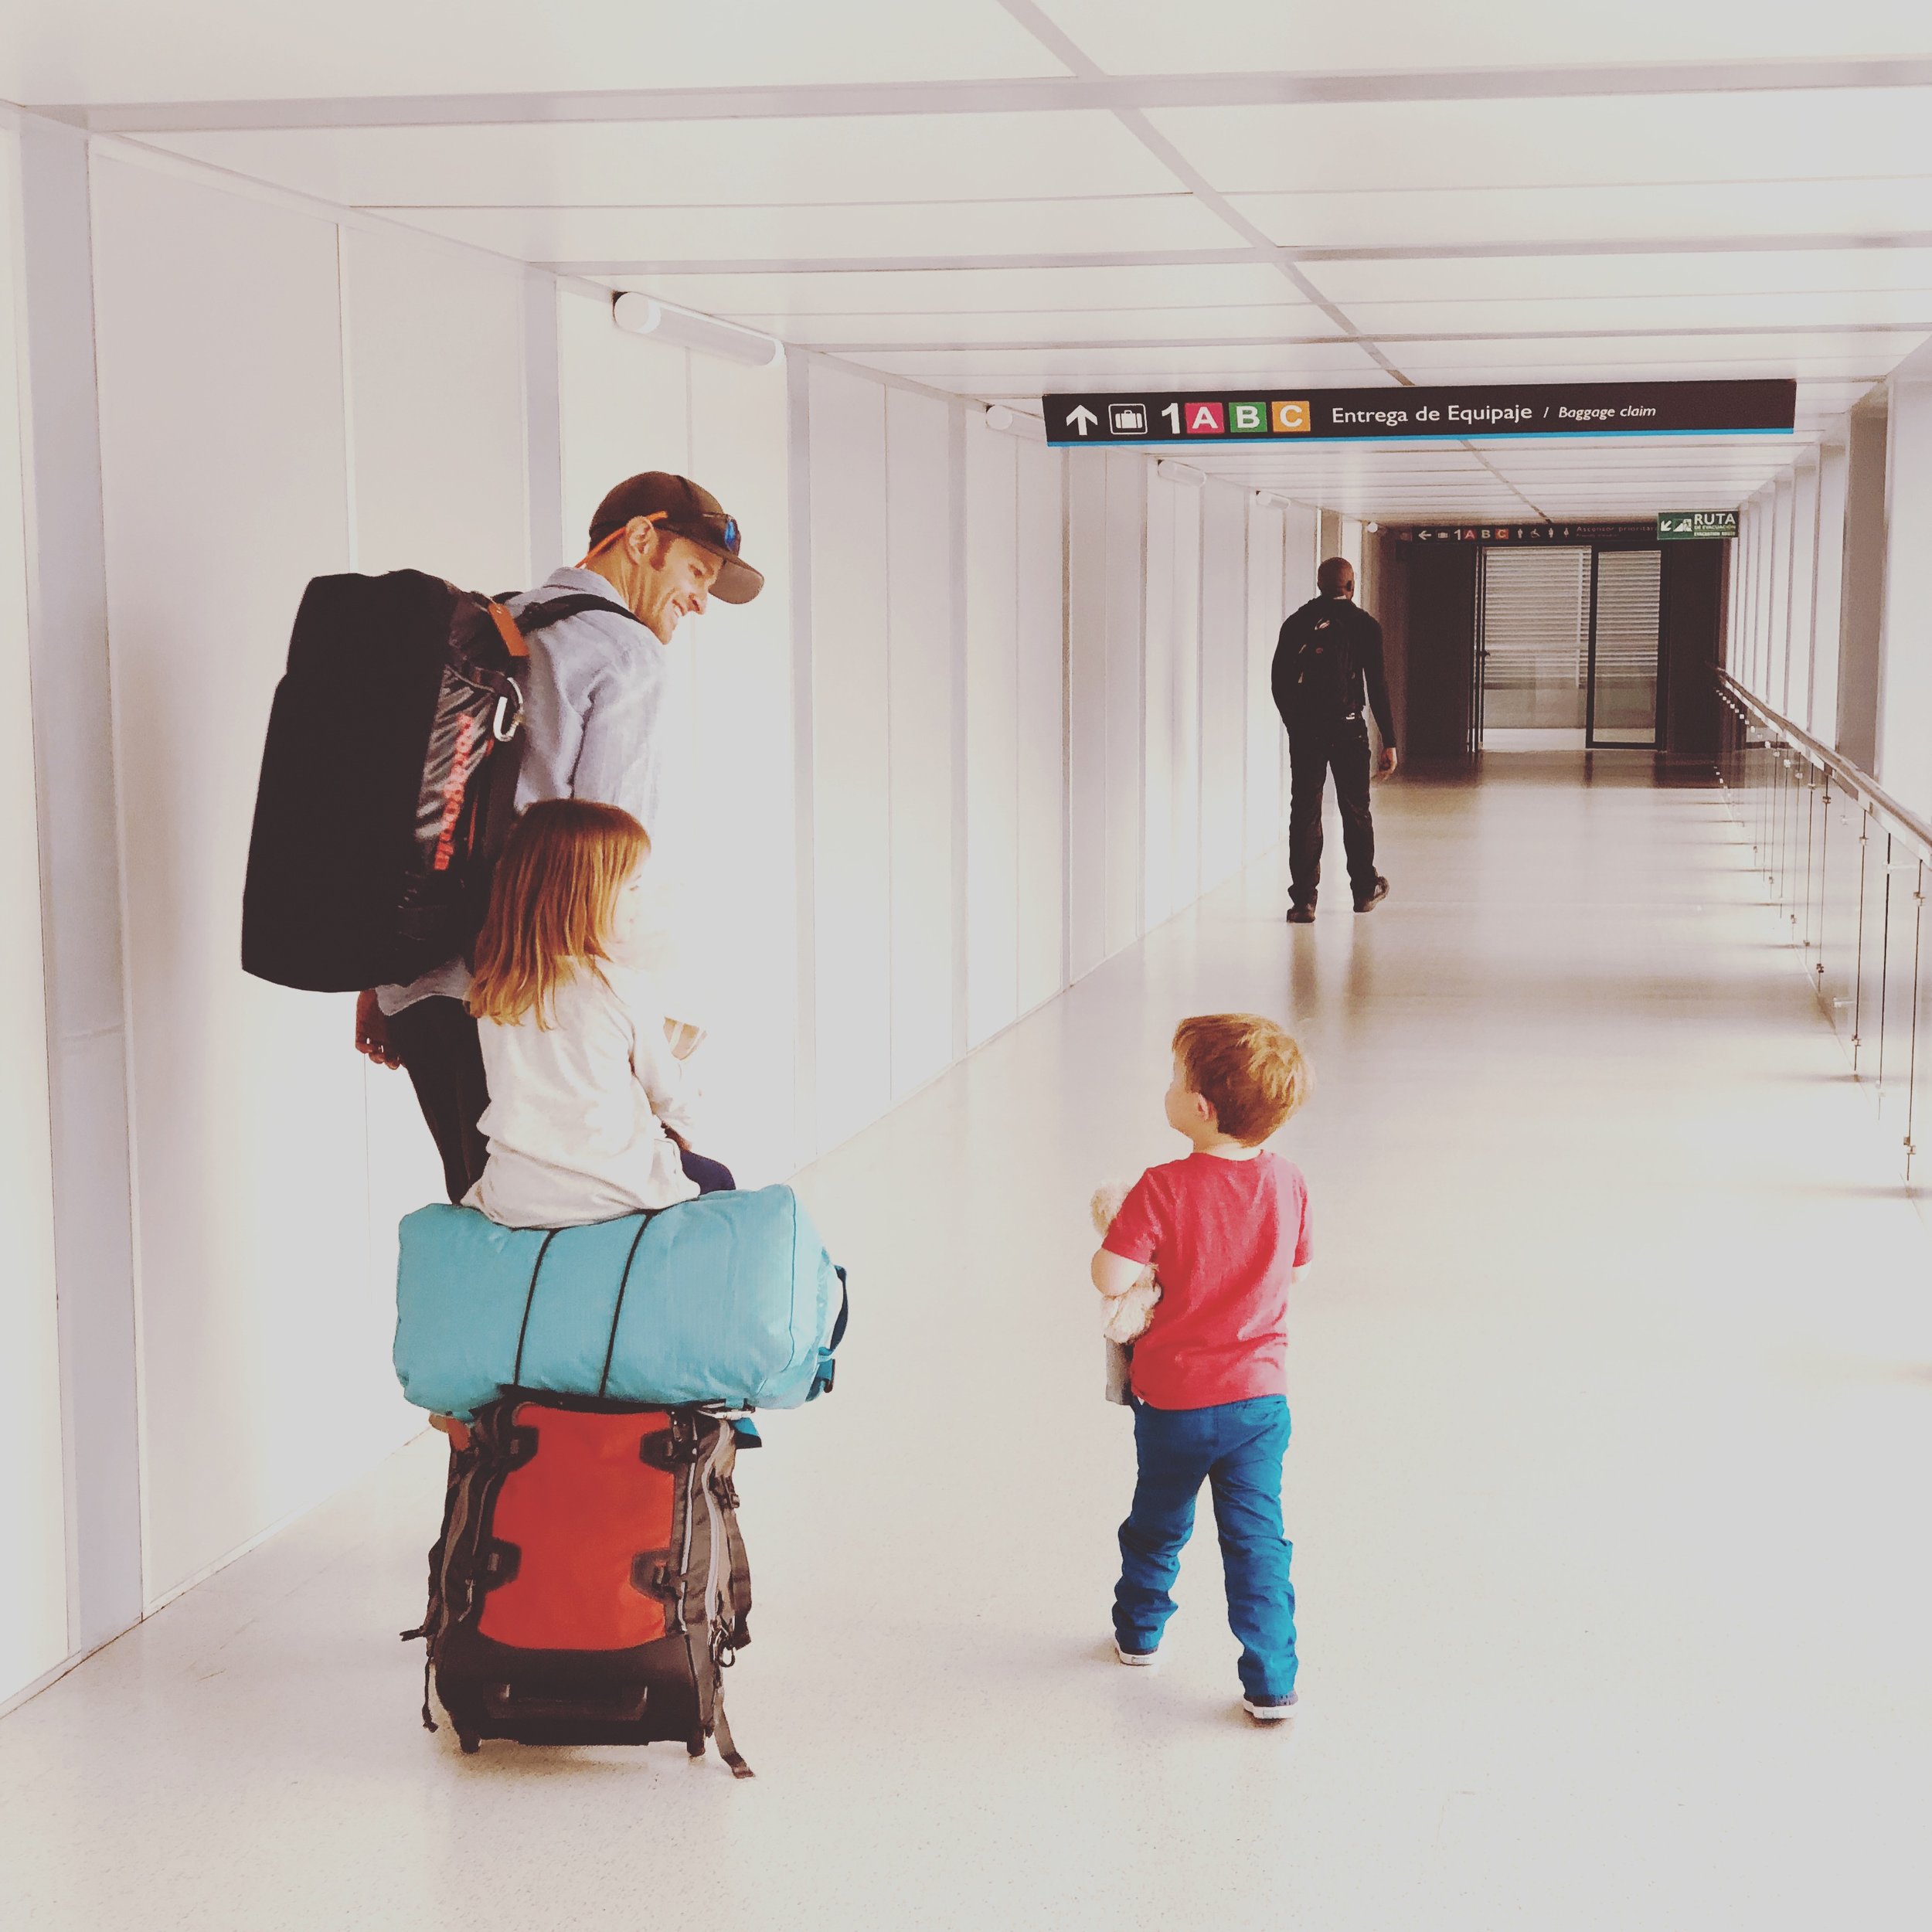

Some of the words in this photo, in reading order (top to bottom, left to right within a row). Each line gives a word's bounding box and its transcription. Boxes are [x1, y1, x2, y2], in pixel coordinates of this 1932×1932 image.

[1162, 403, 1181, 434] 1
[1192, 406, 1219, 430] A
[1236, 405, 1260, 428] B
[1280, 404, 1303, 427] C
[1332, 407, 1409, 427] Entrega
[1415, 406, 1440, 421] de
[1447, 404, 1532, 425] Equipaje
[1558, 406, 1616, 421] Baggage
[1620, 405, 1656, 417] claim
[1694, 513, 1736, 526] RUTA
[1454, 529, 1461, 541] 1
[1464, 529, 1475, 539] A
[1481, 529, 1491, 539] B
[1498, 529, 1508, 538] C
